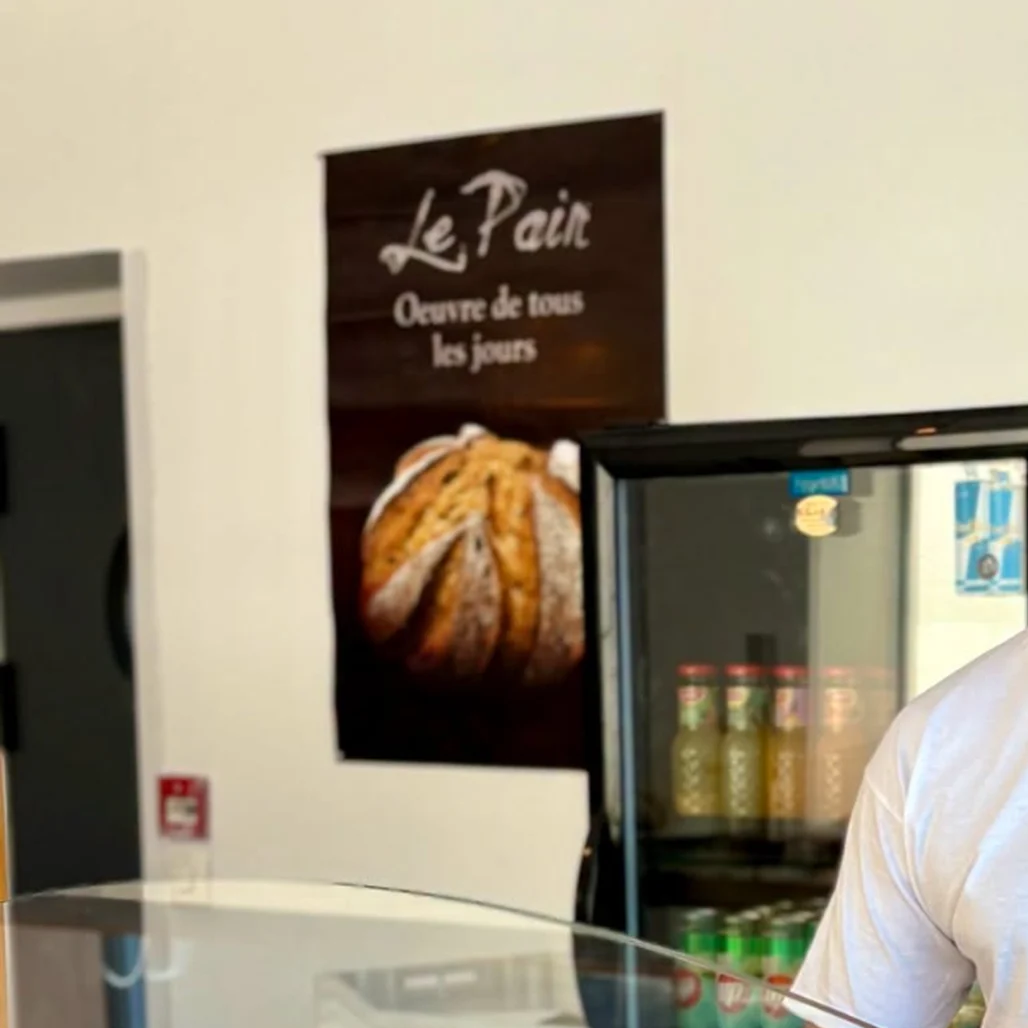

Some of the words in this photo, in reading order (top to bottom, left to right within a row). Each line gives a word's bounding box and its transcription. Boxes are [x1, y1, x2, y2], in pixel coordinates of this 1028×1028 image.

[378, 187, 467, 275] Le
[459, 169, 592, 257] Pain
[393, 291, 487, 328] Oeuvre
[490, 284, 523, 320] de
[527, 290, 586, 317] tous
[432, 332, 467, 368] les
[469, 332, 538, 374] jours
